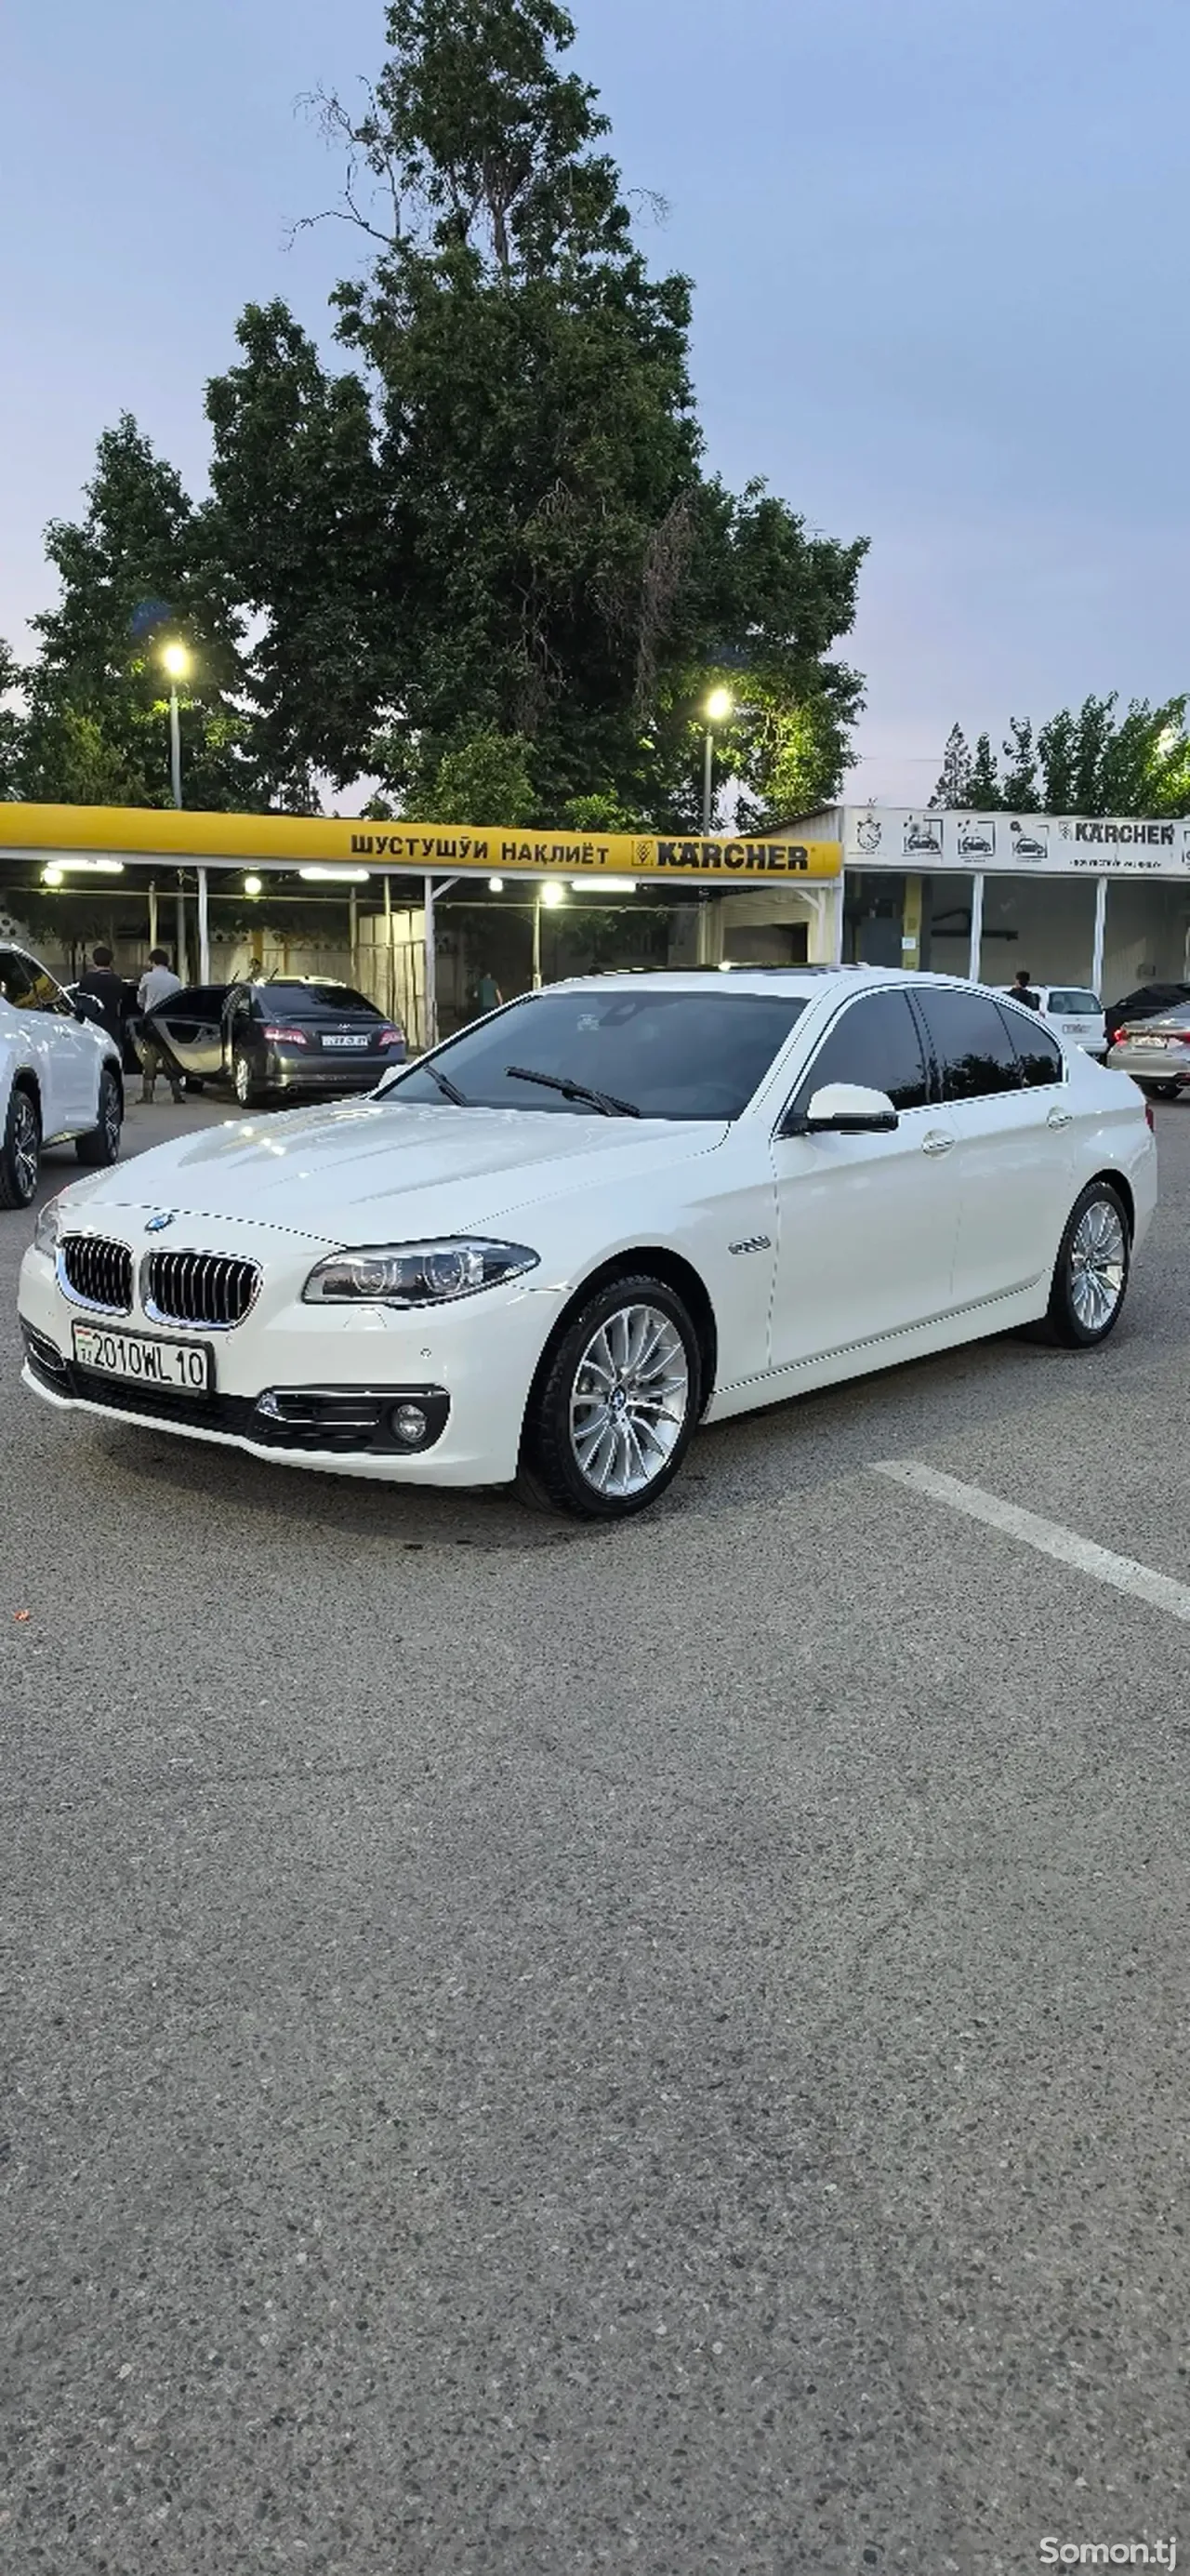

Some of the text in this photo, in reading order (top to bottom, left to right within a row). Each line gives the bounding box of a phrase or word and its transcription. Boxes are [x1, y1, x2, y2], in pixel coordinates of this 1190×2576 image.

[1075, 822, 1175, 845] KÄRCHER
[501, 842, 610, 865] НАҚЛИЁТ
[656, 841, 809, 870] KÄRCHER
[93, 1333, 204, 1386] 2010WL 10
